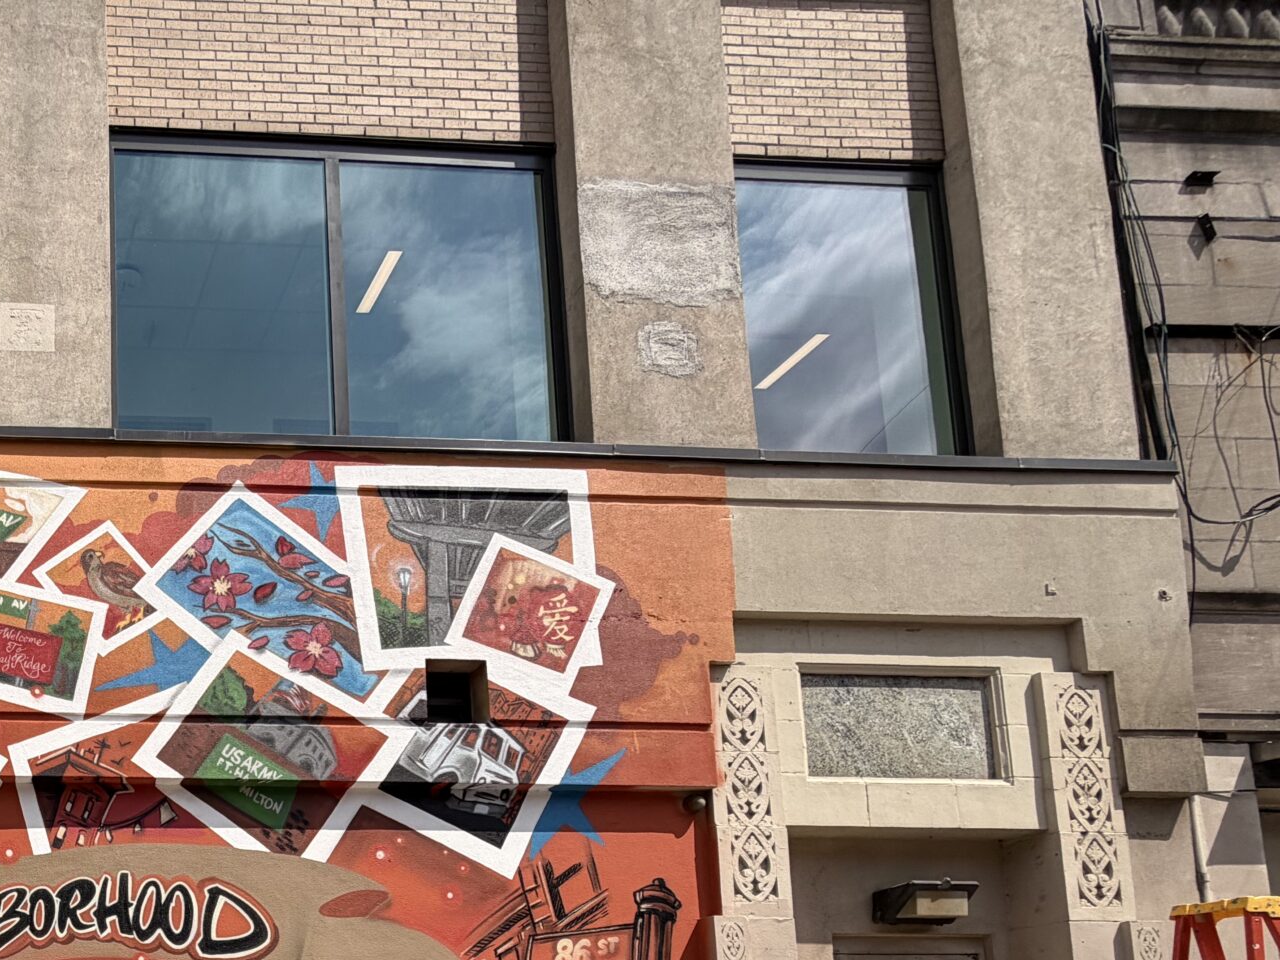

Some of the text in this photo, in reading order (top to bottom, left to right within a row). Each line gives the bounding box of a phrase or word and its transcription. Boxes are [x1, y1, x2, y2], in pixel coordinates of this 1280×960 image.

[11, 599, 28, 611] AV
[537, 591, 580, 644] 愛
[11, 654, 52, 679] Ridge
[596, 936, 620, 956] ST
